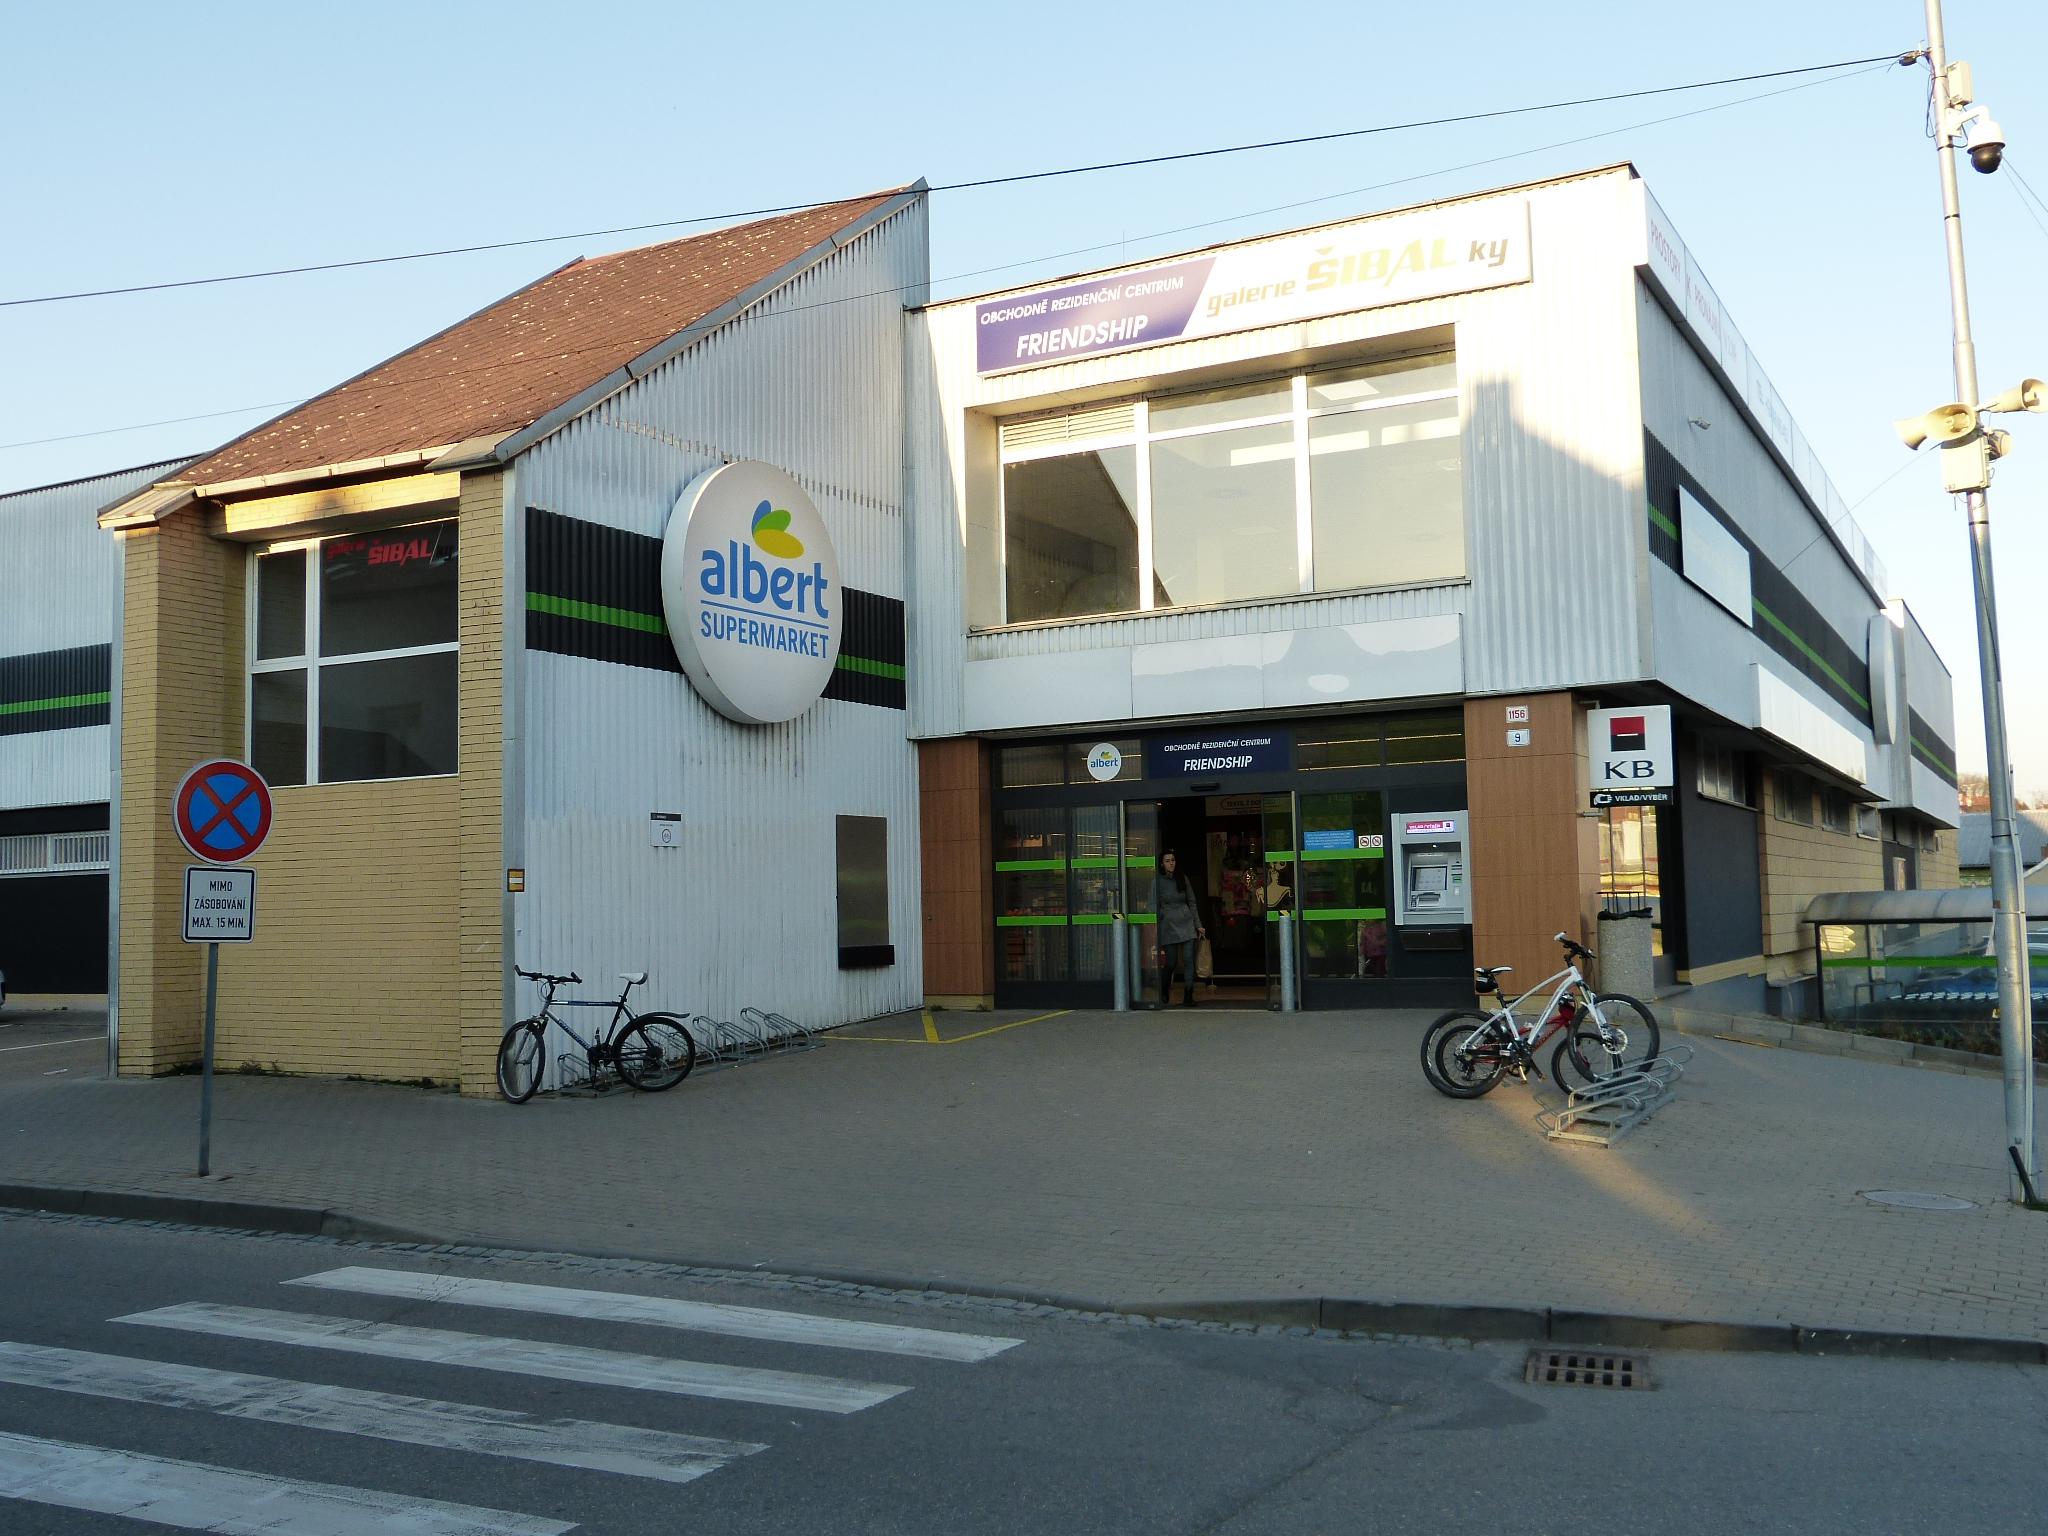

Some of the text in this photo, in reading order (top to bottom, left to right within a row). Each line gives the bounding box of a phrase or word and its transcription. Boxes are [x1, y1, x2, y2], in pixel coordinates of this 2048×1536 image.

[1206, 238, 1509, 318] galerie ŠIBAL ky
[980, 276, 1184, 325] OBCHODNĚ REZIDENČNÍ CENTRUM
[1016, 314, 1149, 358] FRIENDSHIP
[700, 540, 829, 619] albert
[700, 610, 829, 659] SUPERMARKET
[1508, 709, 1526, 719] 1156
[1164, 737, 1271, 752] OBCHODNĚ REZIDENČNÍ CENTRUM
[1514, 732, 1521, 743] 9
[1090, 757, 1119, 768] albert
[1183, 755, 1253, 772] FRIENDSHIP
[1603, 760, 1655, 780] KB
[209, 880, 233, 892] MIMO
[194, 896, 247, 910] ZÁSOBOVÁNÍ
[192, 916, 246, 929] MAX. 15 MIN.
